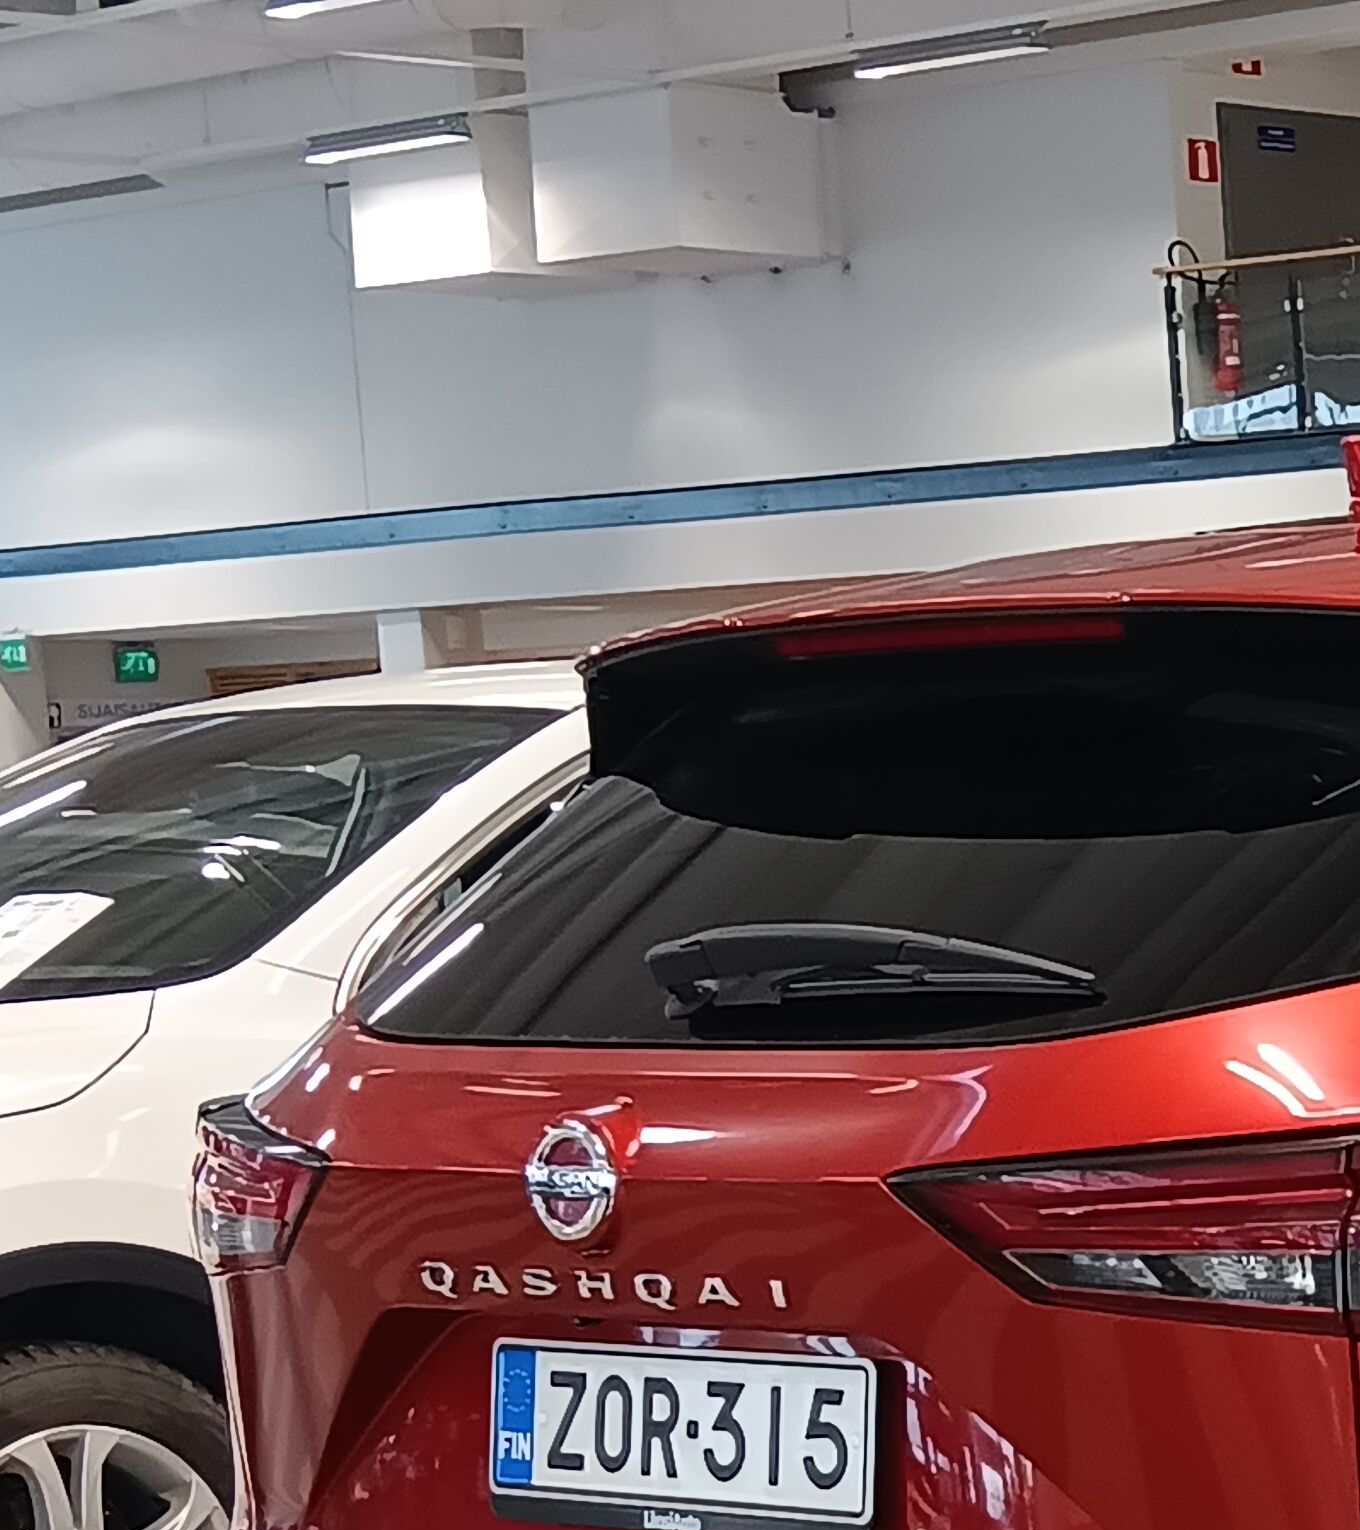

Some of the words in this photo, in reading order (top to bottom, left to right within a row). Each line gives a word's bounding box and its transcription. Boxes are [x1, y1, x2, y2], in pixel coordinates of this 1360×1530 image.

[419, 1260, 790, 1311] QASHQAI
[498, 1429, 532, 1462] FIN
[547, 1370, 849, 1490] ZOR-315
